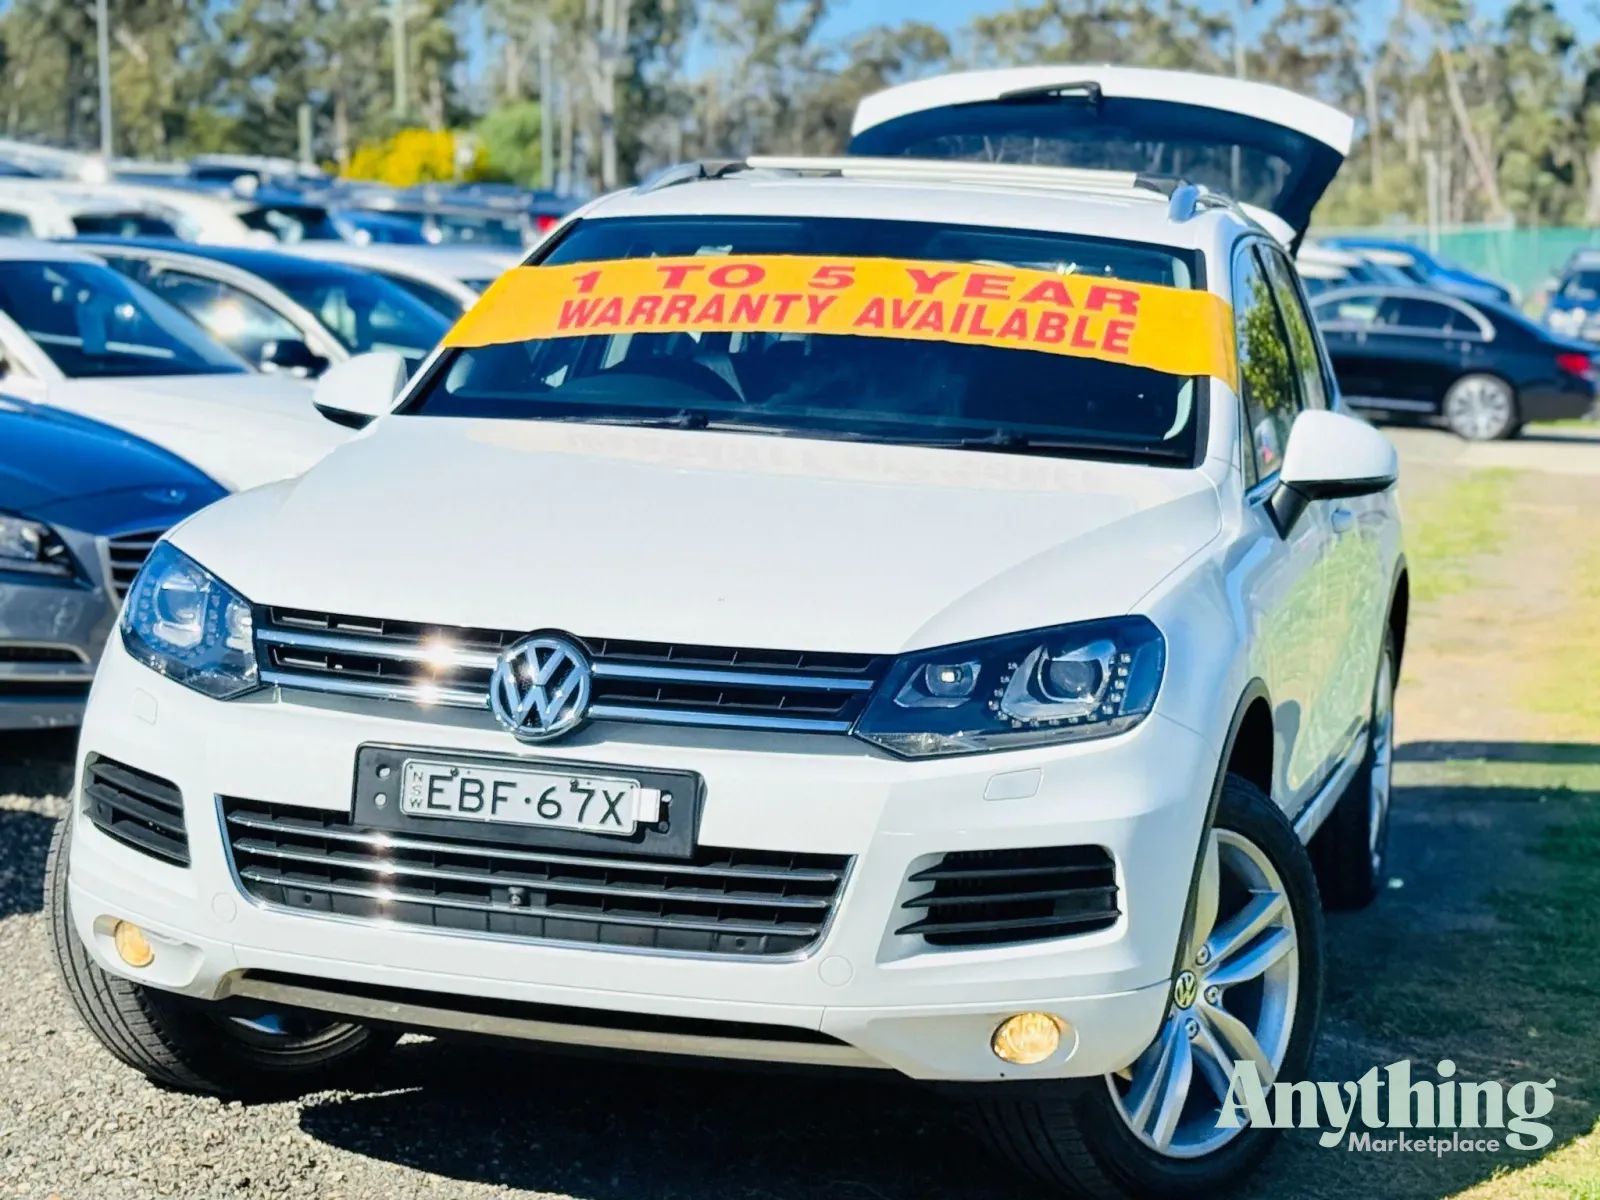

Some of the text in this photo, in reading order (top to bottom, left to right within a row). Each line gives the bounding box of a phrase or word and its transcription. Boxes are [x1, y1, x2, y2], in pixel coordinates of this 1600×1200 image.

[572, 264, 1141, 316] 1 TO 5 YEAR
[556, 293, 1136, 355] WARRANTY AVAILABLE
[410, 771, 424, 810] NSW
